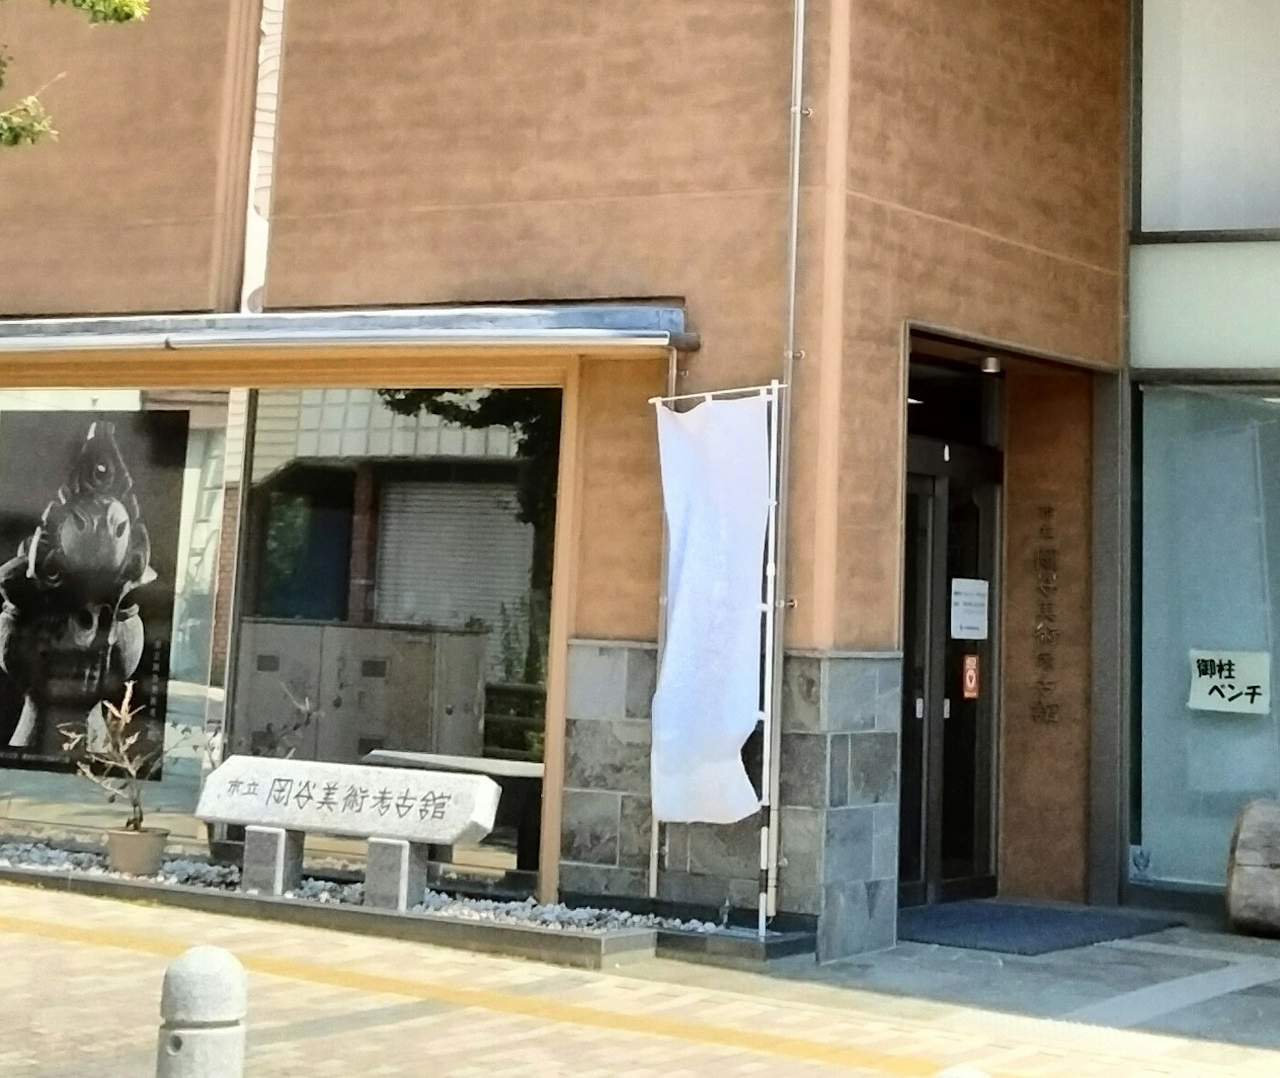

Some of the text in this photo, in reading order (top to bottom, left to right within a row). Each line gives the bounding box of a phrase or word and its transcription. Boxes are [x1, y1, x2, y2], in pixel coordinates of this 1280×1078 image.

[1196, 658, 1236, 680] 御柱
[1208, 683, 1263, 705] ベンチ
